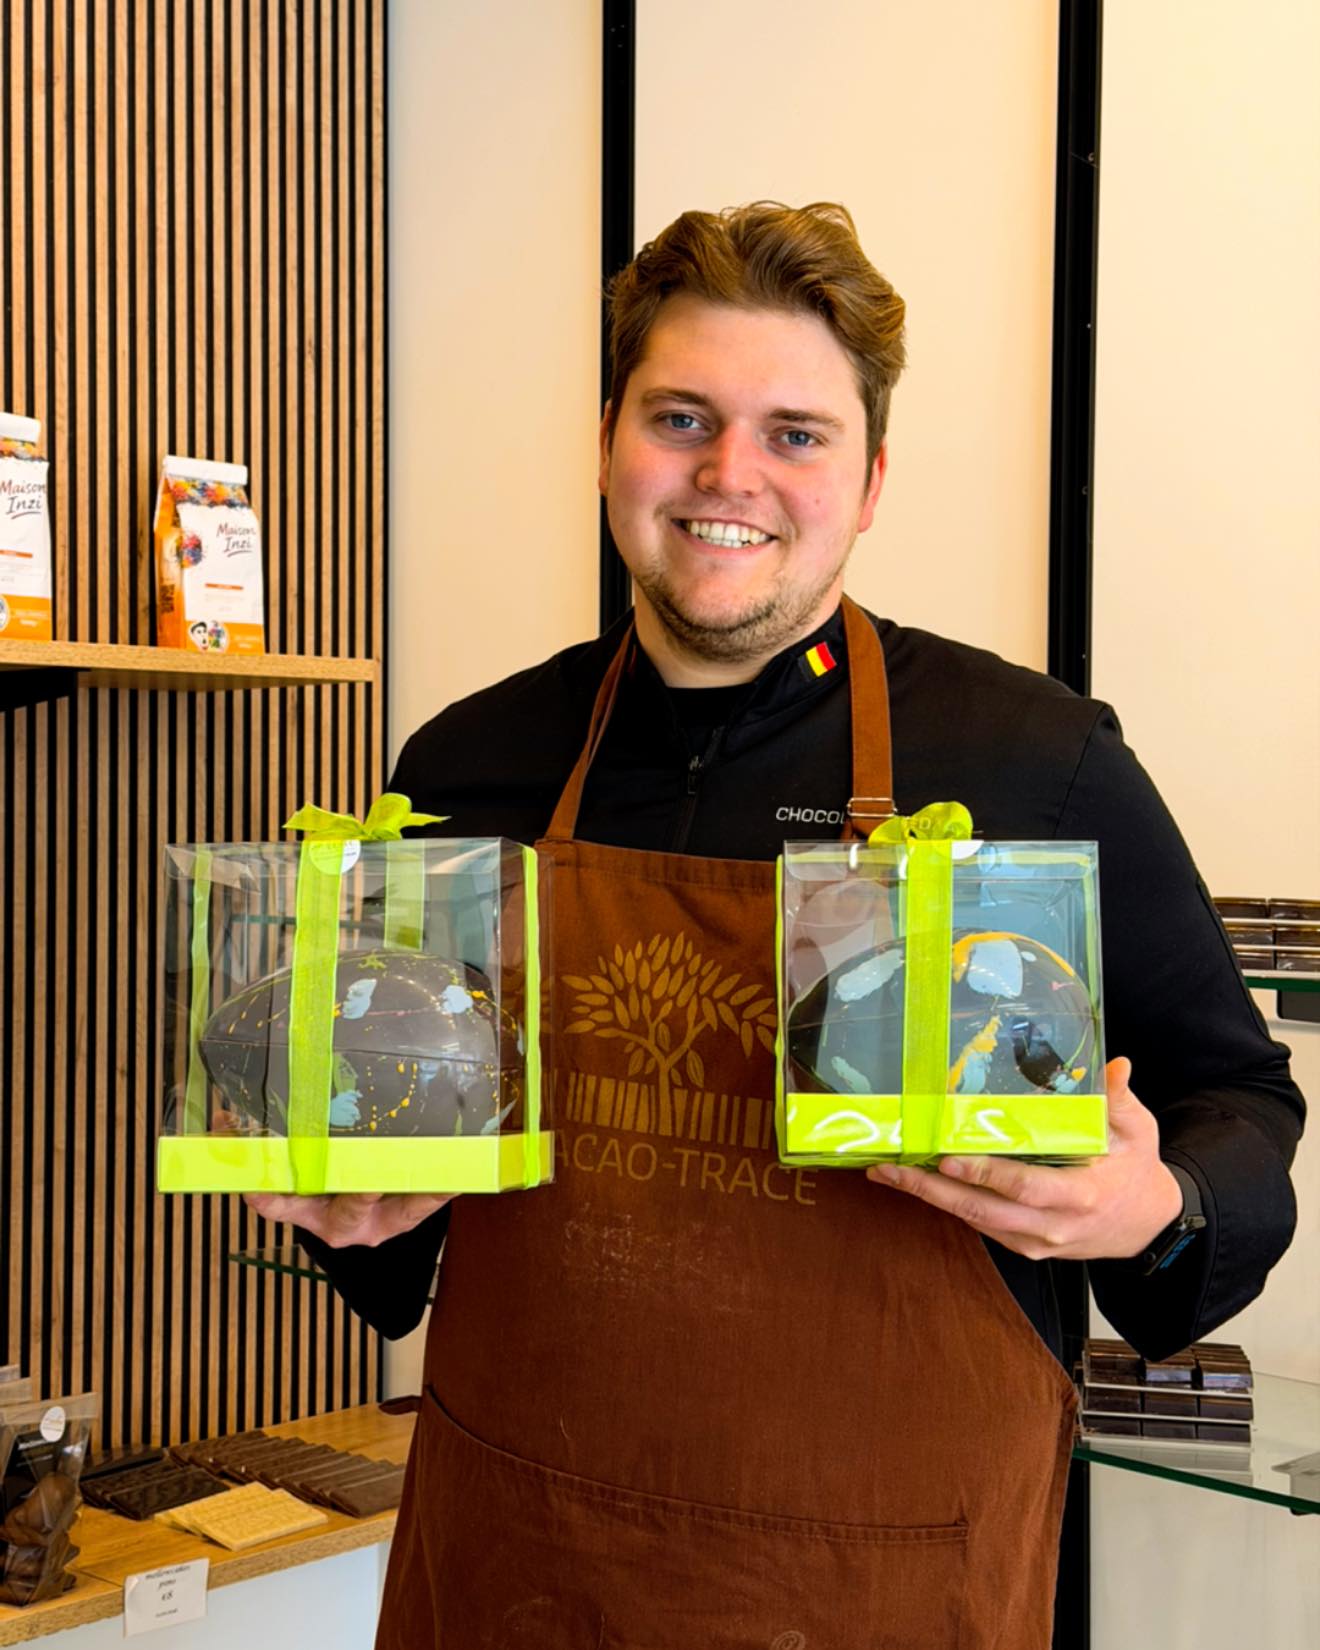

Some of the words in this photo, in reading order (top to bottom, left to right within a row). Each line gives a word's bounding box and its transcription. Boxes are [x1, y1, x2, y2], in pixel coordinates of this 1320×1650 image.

[0, 479, 47, 496] Maison
[5, 495, 42, 515] Inzi
[216, 522, 256, 538] Maison
[222, 536, 252, 553] Inzi
[775, 806, 845, 825] CHOCOL
[554, 1128, 818, 1205] ACAO-TRACE
